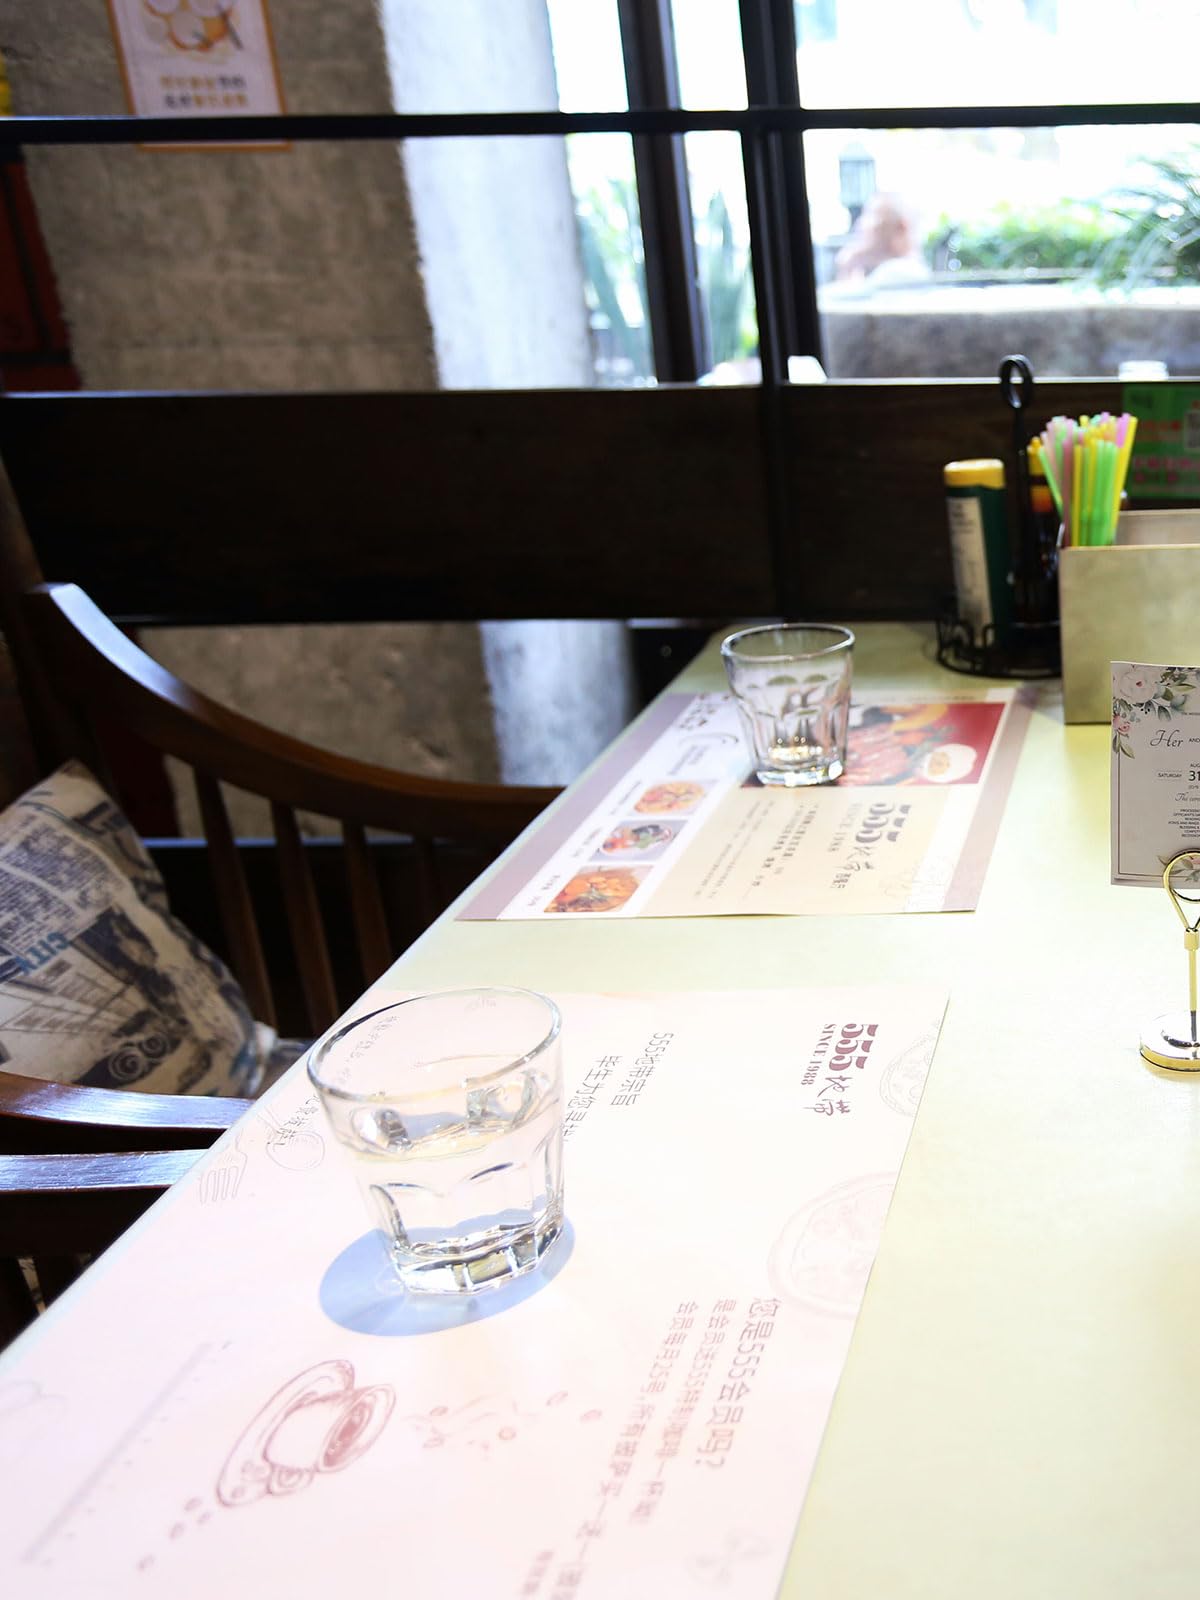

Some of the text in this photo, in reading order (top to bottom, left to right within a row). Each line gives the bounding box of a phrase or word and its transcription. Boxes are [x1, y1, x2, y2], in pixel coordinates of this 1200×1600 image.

[1149, 729, 1183, 747] Her
[1188, 770, 1200, 782] 31
[855, 803, 911, 843] 555
[610, 1032, 675, 1106] 555地带宗旨
[800, 1023, 837, 1085] SINCE 1988
[829, 1023, 879, 1071] 555
[694, 1297, 782, 1469] 您是555会员吗?
